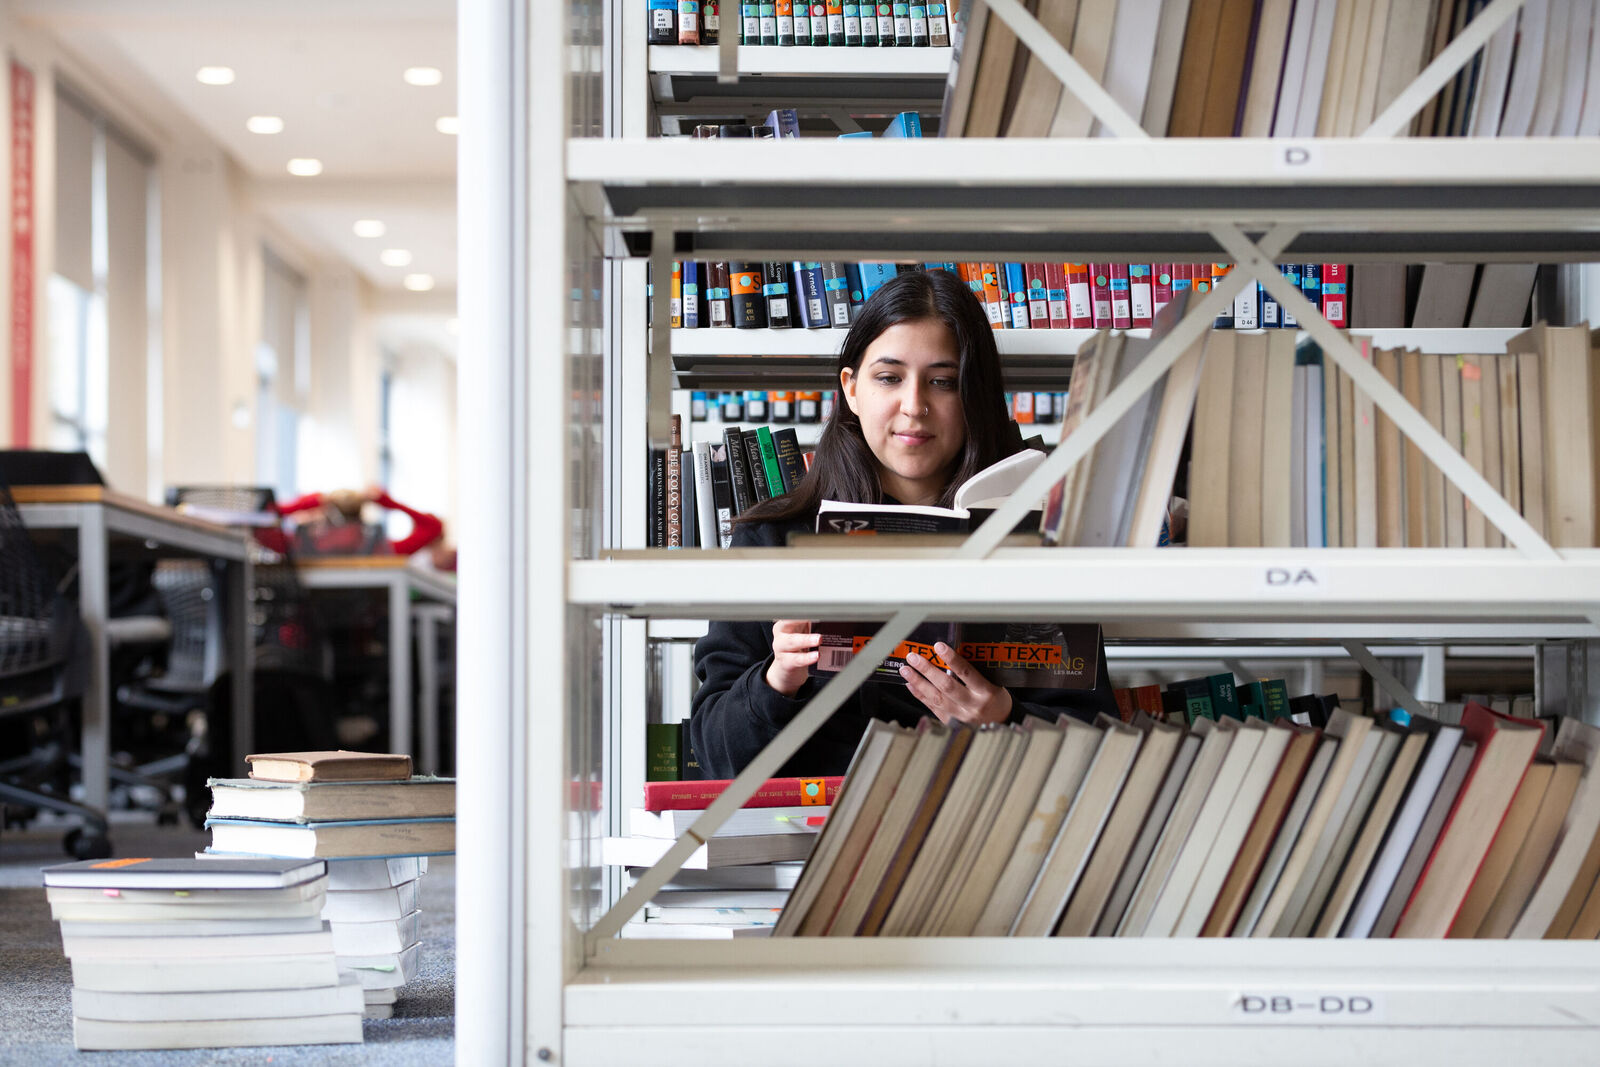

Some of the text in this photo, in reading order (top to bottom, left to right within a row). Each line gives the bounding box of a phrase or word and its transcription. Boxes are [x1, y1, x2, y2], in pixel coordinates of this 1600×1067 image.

[1285, 148, 1310, 165] D
[808, 271, 817, 296] Arnold
[670, 449, 679, 467] THE
[670, 469, 679, 511] ECOLOGY
[670, 513, 679, 525] OF
[1266, 567, 1317, 585] DA
[962, 645, 998, 660] SET
